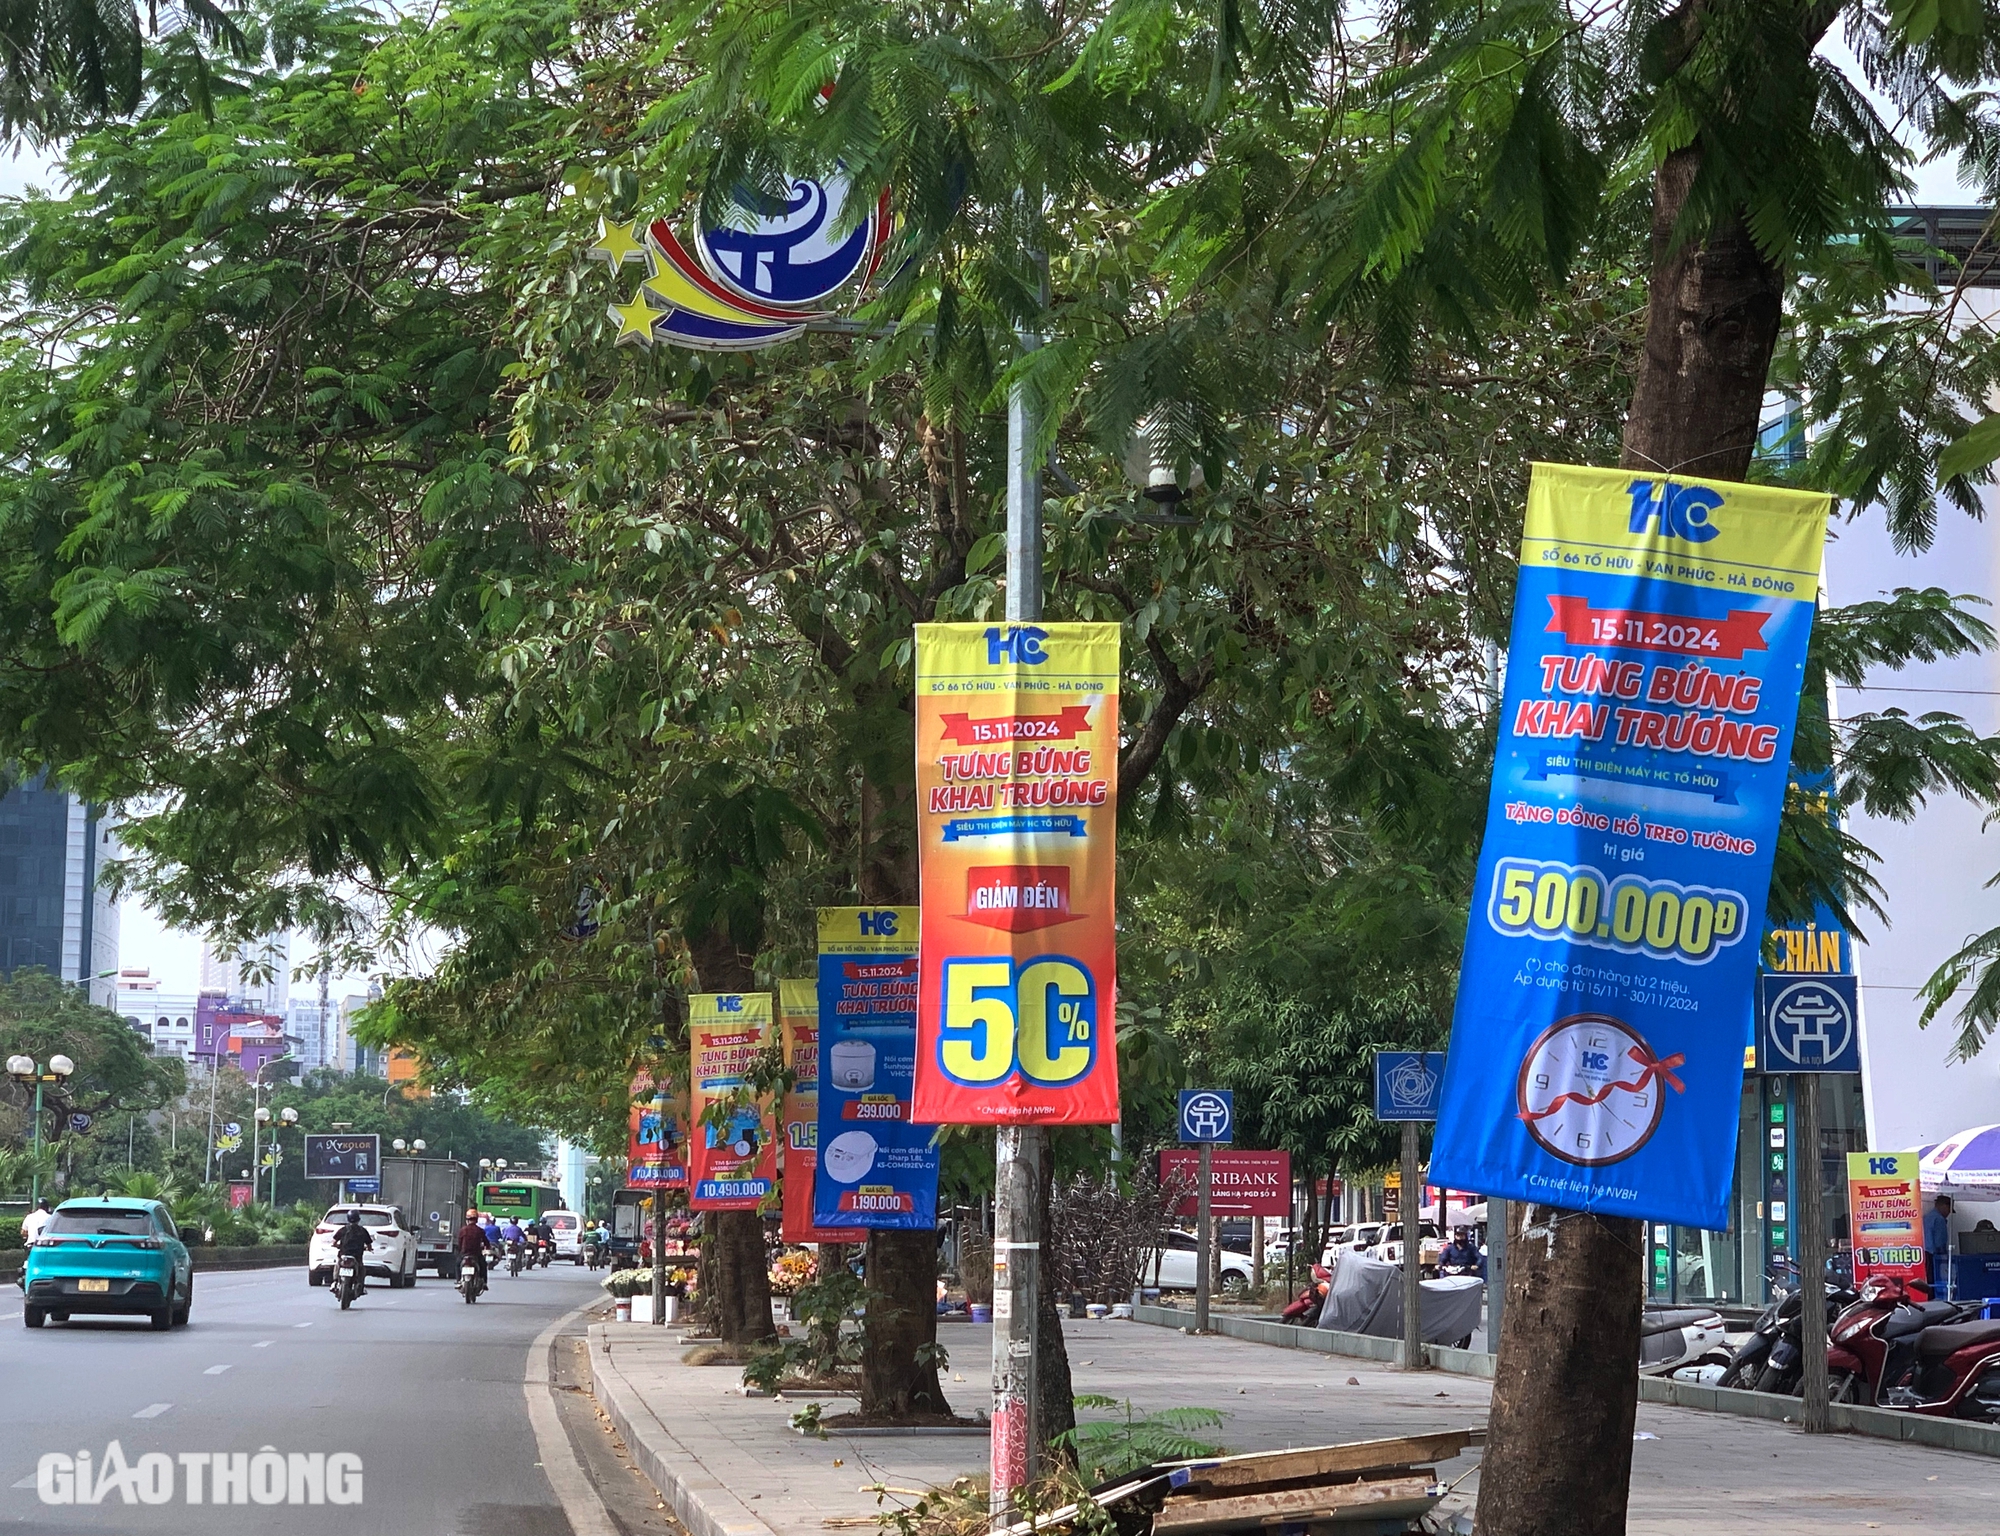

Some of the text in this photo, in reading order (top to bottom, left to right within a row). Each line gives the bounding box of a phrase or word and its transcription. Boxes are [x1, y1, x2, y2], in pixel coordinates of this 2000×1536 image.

[1625, 480, 1726, 543] HC
[1542, 547, 1560, 561] SỐ
[1563, 552, 1580, 564] 66
[1584, 552, 1602, 566] TỐ
[1606, 555, 1633, 570] HỮU
[1645, 560, 1674, 577] VẠN
[1677, 566, 1716, 582] PHÚC
[1727, 572, 1747, 587] HÀ
[1752, 575, 1795, 593] ĐÔNG
[1591, 617, 1720, 651] 15.11.2024
[983, 626, 1050, 666] HC
[932, 680, 945, 692] SỐ
[947, 682, 959, 691] 66
[962, 679, 974, 691] TỐ
[976, 681, 996, 691] HỮU
[1024, 679, 1050, 690] PHÚC
[1058, 679, 1072, 690] HÀ
[1075, 679, 1104, 691] ĐÔNG
[1540, 653, 1763, 714] TƯNG BỪNG
[972, 721, 1060, 741] 15.11.2024
[1513, 699, 1779, 763] KHAI TRƯƠNG
[941, 745, 1092, 780] TƯNG BỪNG
[1546, 756, 1719, 787] SIÊU THỊ ĐIỆN MÁY HC TỐ HỮU
[929, 778, 1108, 813] KHAI TRƯƠNG
[956, 821, 974, 832] SIÊU
[1027, 819, 1039, 828] HC
[1041, 817, 1053, 828] TỐ
[1505, 801, 1756, 856] TẶNG ĐỒNG HỒ TREO TƯỜNG
[1604, 843, 1645, 863] trị giá
[976, 879, 1059, 910] GIẢM ĐẾN
[857, 911, 899, 936] HC
[858, 966, 903, 978] 15.11.2024
[1544, 960, 1569, 973] cho
[1572, 964, 1595, 979] đơn
[1598, 968, 1631, 986] hàng
[1634, 974, 1647, 987] từ
[1650, 977, 1657, 989] 2
[842, 981, 878, 998] TƯNG
[1513, 970, 1699, 1012] Áp dụng từ 15/11 30/11/2024
[716, 996, 744, 1013] HC
[836, 998, 917, 1015] KHAI TRƯƠN
[712, 1036, 749, 1046] 15.11.2024
[700, 1050, 728, 1062] TƯNG
[696, 1064, 721, 1078] KHAI
[857, 1103, 901, 1119] 299.000
[1033, 1105, 1056, 1115] NVBH
[325, 1139, 371, 1154] MYKOLOR
[1868, 1157, 1898, 1175] HC
[1188, 1172, 1279, 1185] ARIBANK
[1529, 1174, 1638, 1201] Chi tiết liên hệ NVBH
[703, 1182, 765, 1197] 10.490.000
[1260, 1188, 1270, 1197] SỐ
[1869, 1188, 1901, 1197] 15.11.2024
[852, 1195, 900, 1210] 1.190.000
[1856, 1211, 1878, 1221] KHAI
[1881, 1246, 1921, 1267] TRIỆU
